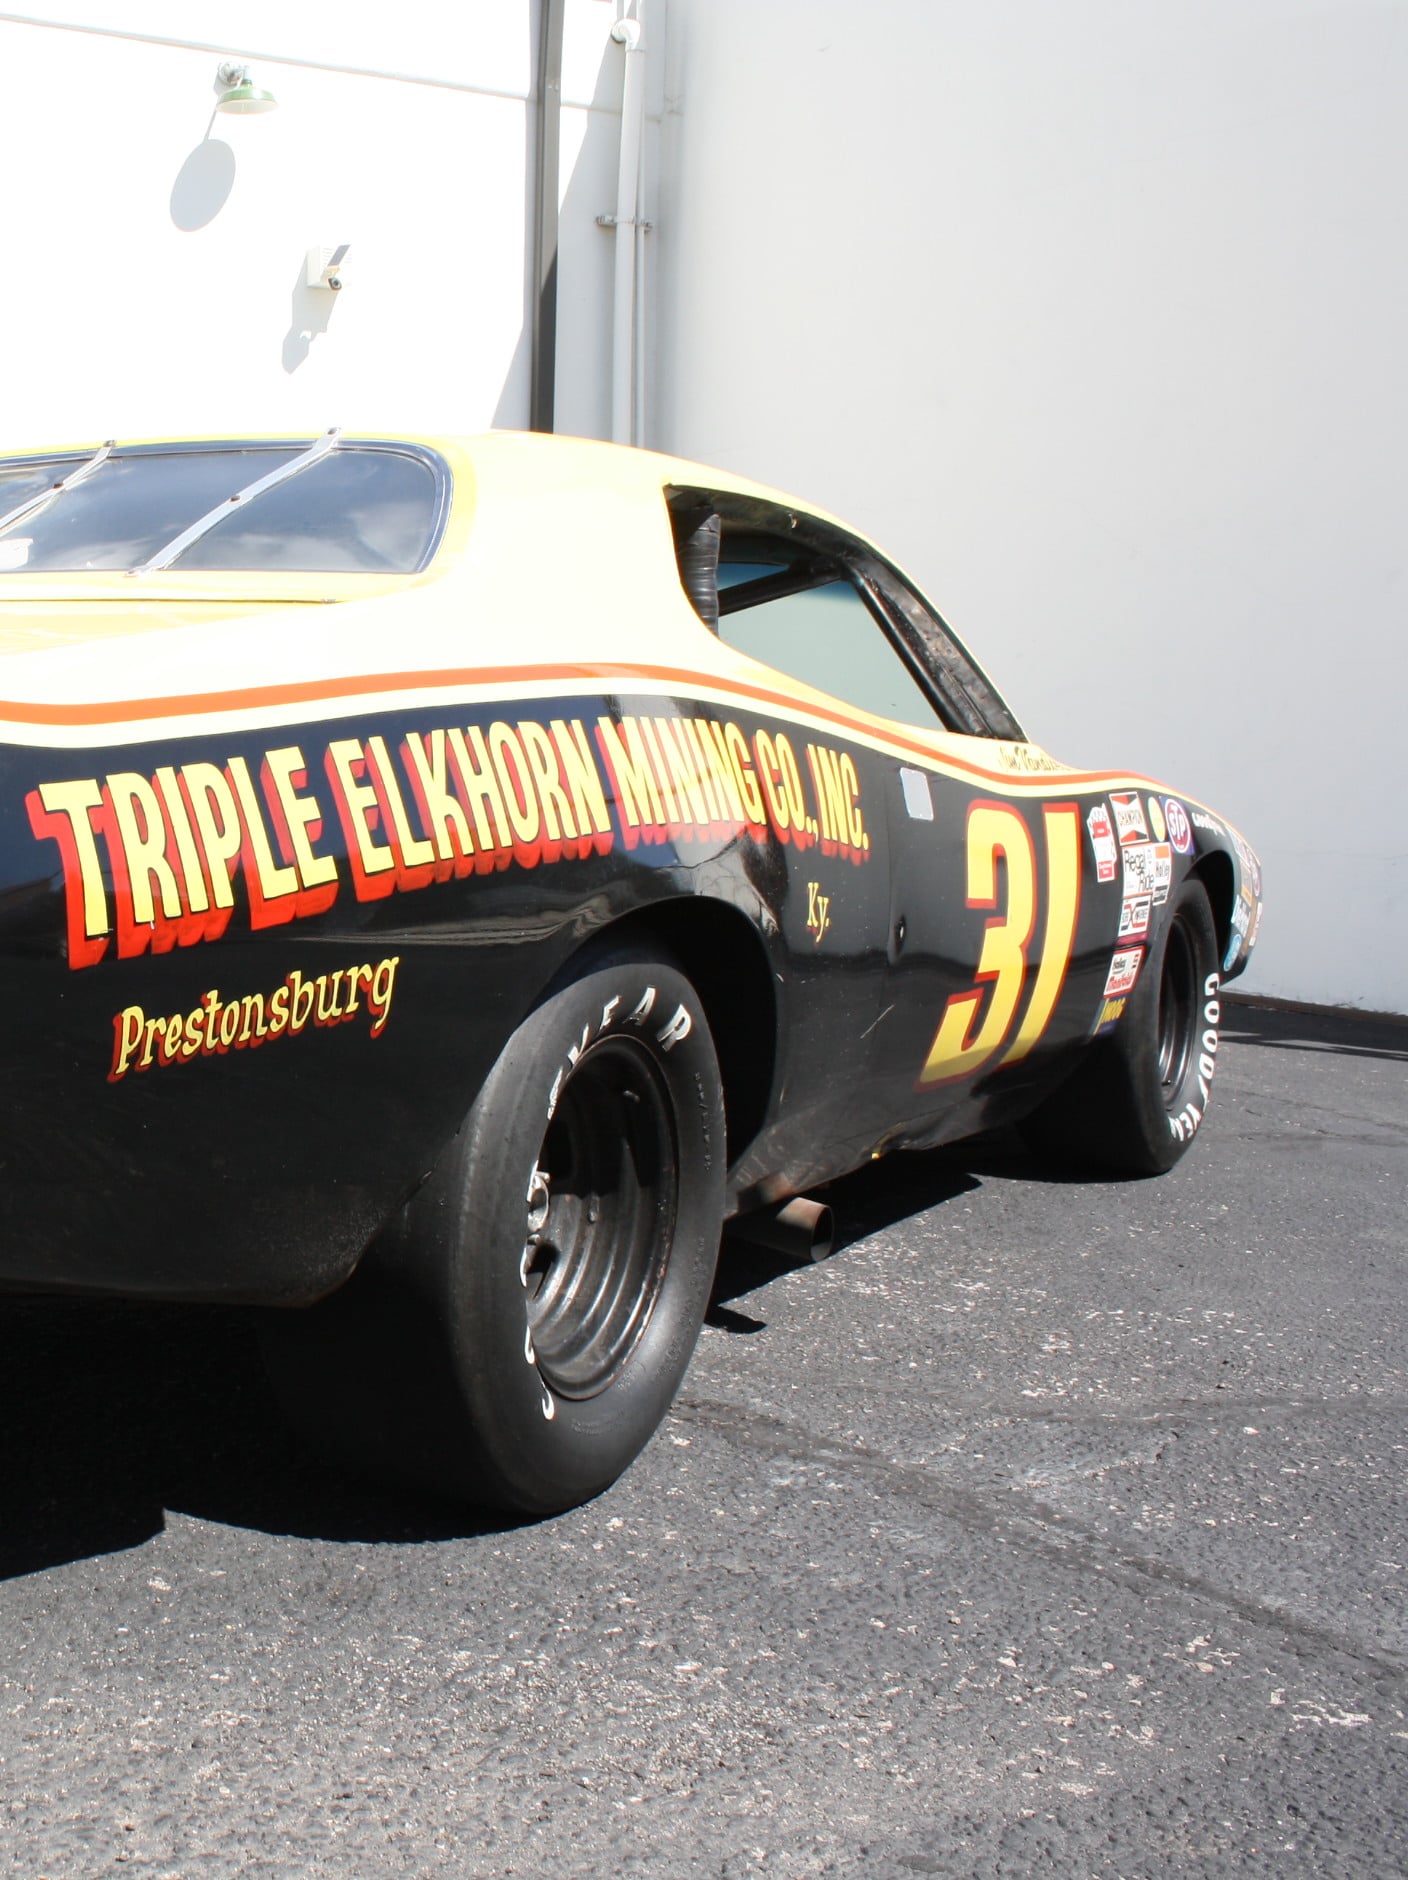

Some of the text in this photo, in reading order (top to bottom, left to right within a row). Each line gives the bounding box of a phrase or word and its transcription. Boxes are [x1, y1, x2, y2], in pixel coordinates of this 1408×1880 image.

[37, 746, 339, 938] TRIPLE
[328, 717, 612, 877] ELKHORN
[604, 714, 768, 828] MINING
[807, 742, 869, 851] INC.
[1117, 809, 1144, 828] CHAMPION
[1168, 804, 1187, 841] STP
[807, 882, 830, 943] Ky.
[916, 800, 1081, 1088] 31
[114, 956, 400, 1074] Prestonsburg
